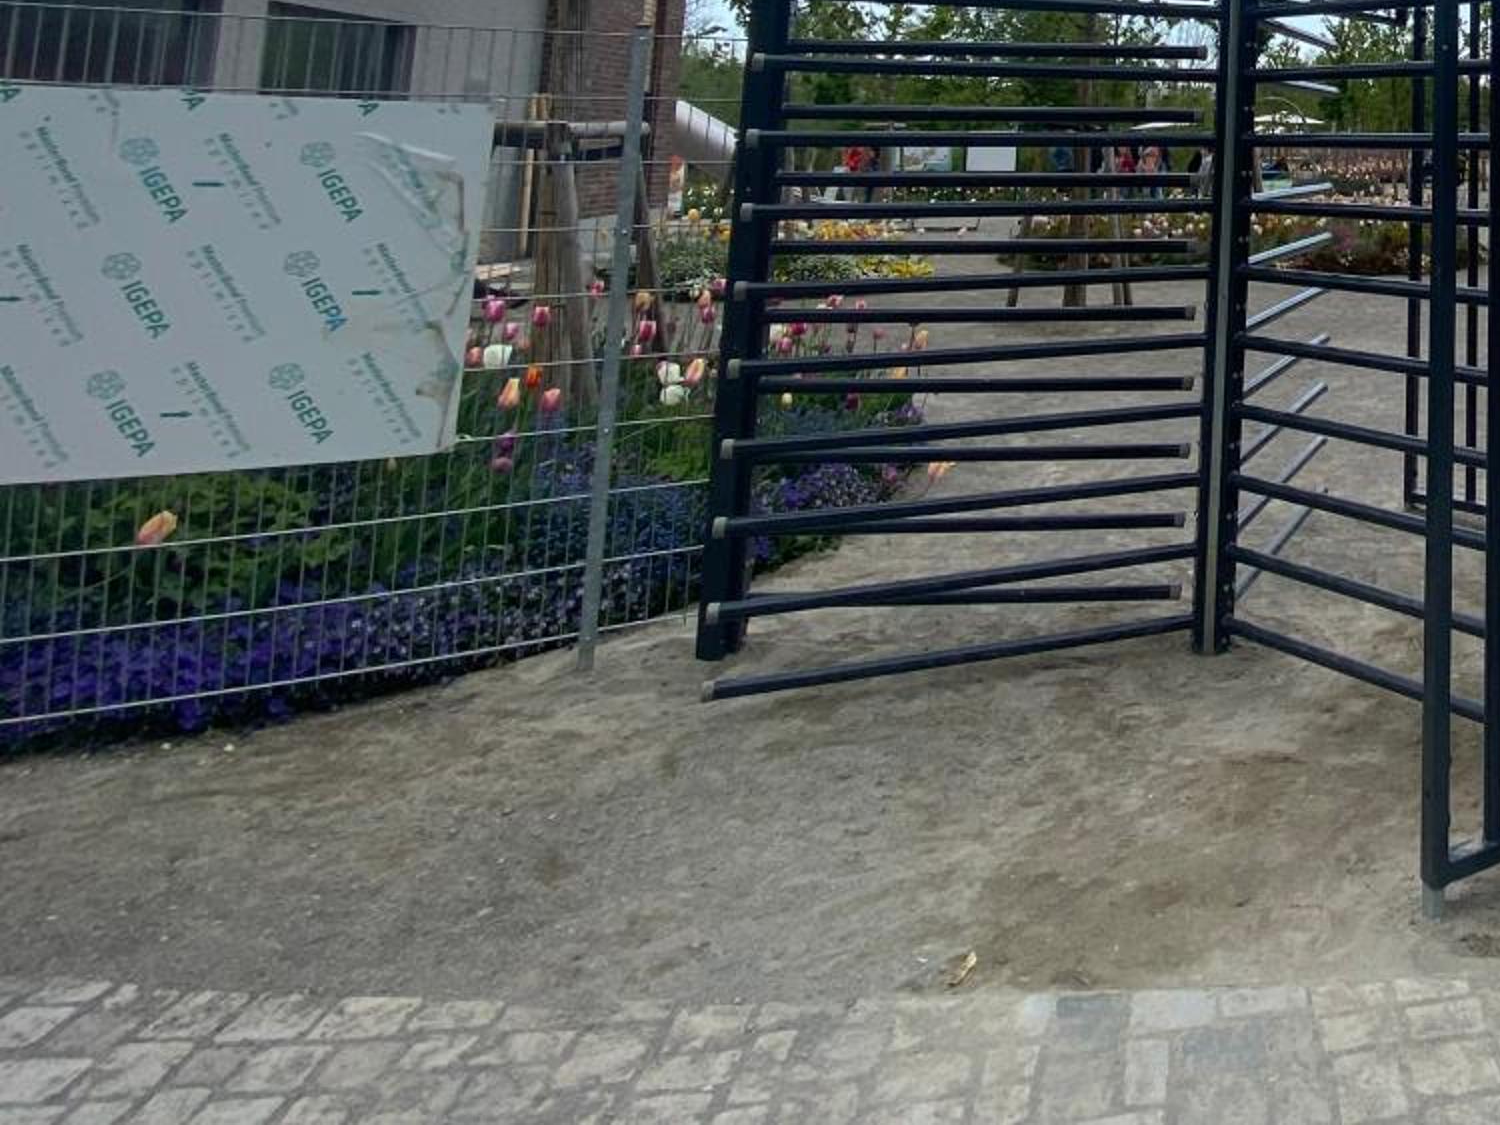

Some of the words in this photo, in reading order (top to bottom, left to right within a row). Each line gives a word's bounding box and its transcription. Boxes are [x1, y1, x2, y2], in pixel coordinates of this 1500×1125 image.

[140, 166, 188, 223] IGEPA
[316, 169, 364, 222] IGEPA
[121, 280, 171, 339] IGEPA
[302, 277, 348, 332] IGEPA
[106, 399, 156, 457] IGEPA
[287, 390, 334, 444] IGEPA
